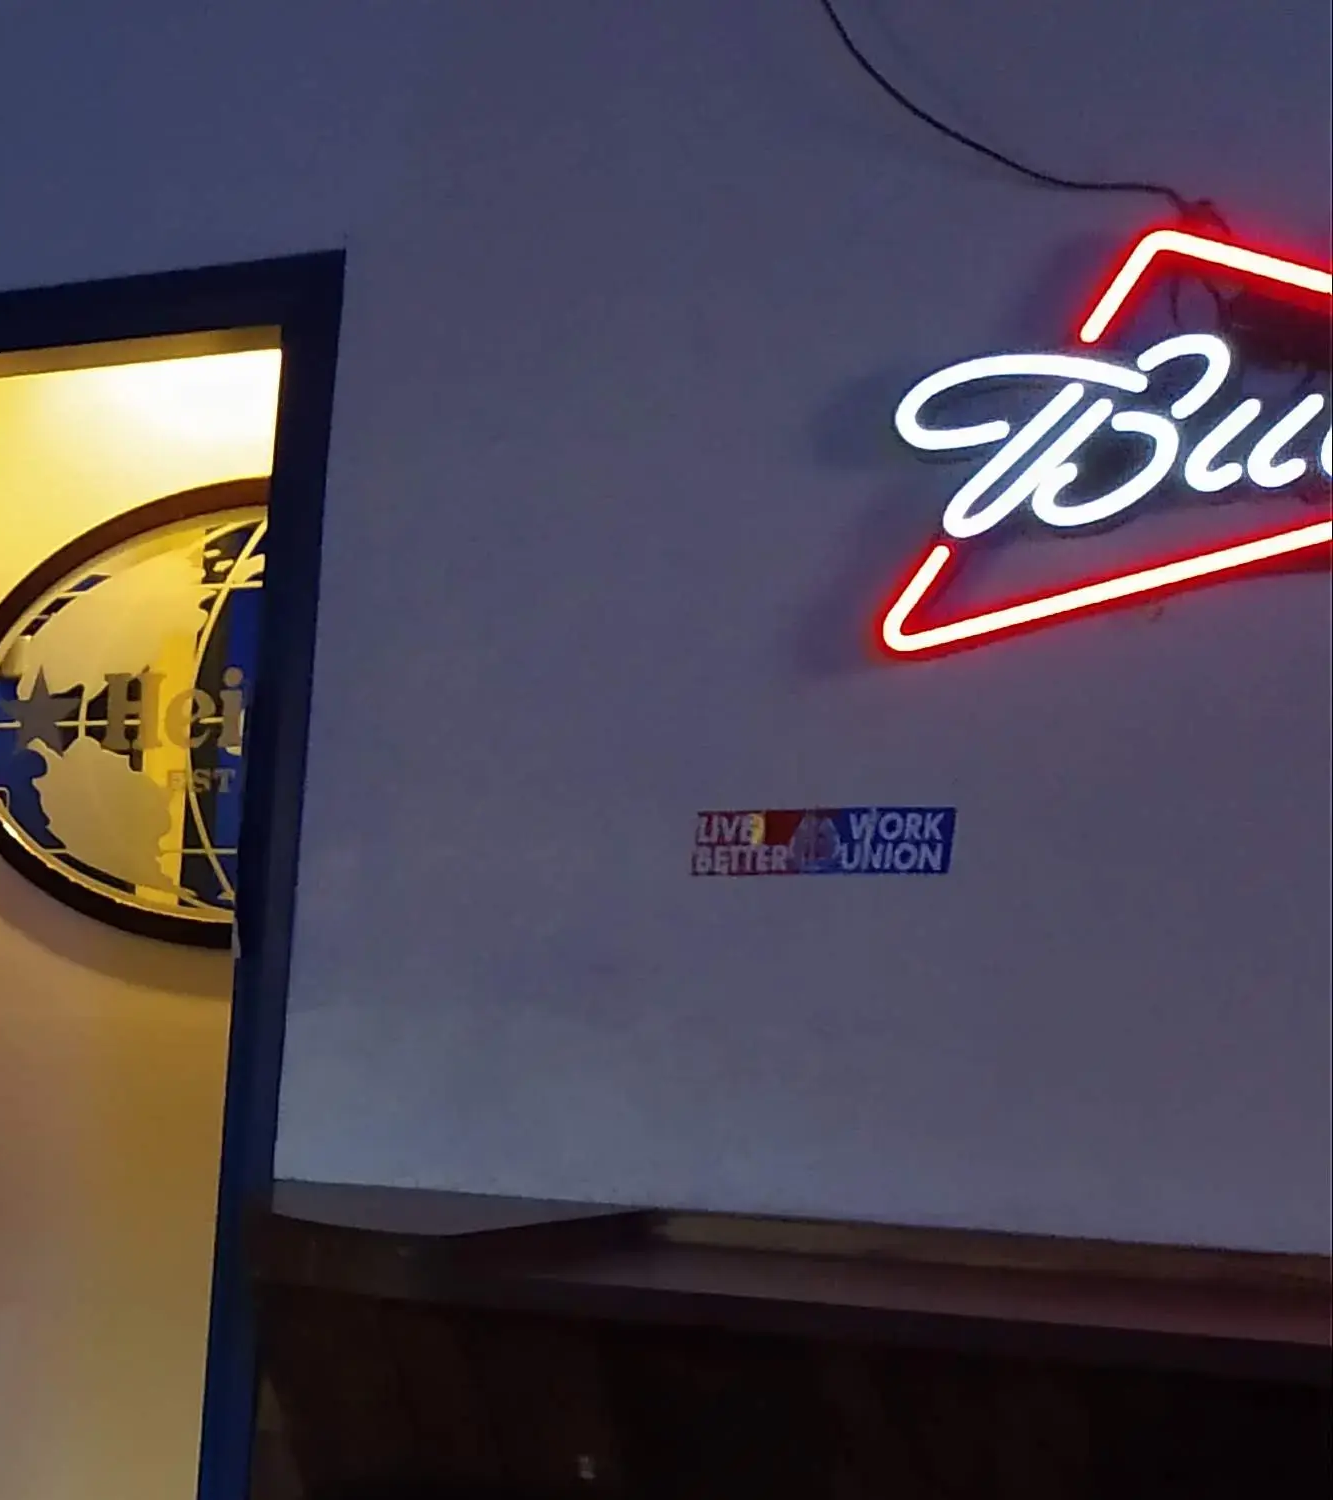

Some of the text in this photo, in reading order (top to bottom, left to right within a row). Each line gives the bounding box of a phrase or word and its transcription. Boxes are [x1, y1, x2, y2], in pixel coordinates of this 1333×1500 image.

[895, 333, 1333, 538] Bu
[696, 814, 761, 844] LIVE
[849, 812, 944, 842] WORK
[693, 845, 791, 873] BETTER
[841, 842, 943, 872] UNION
